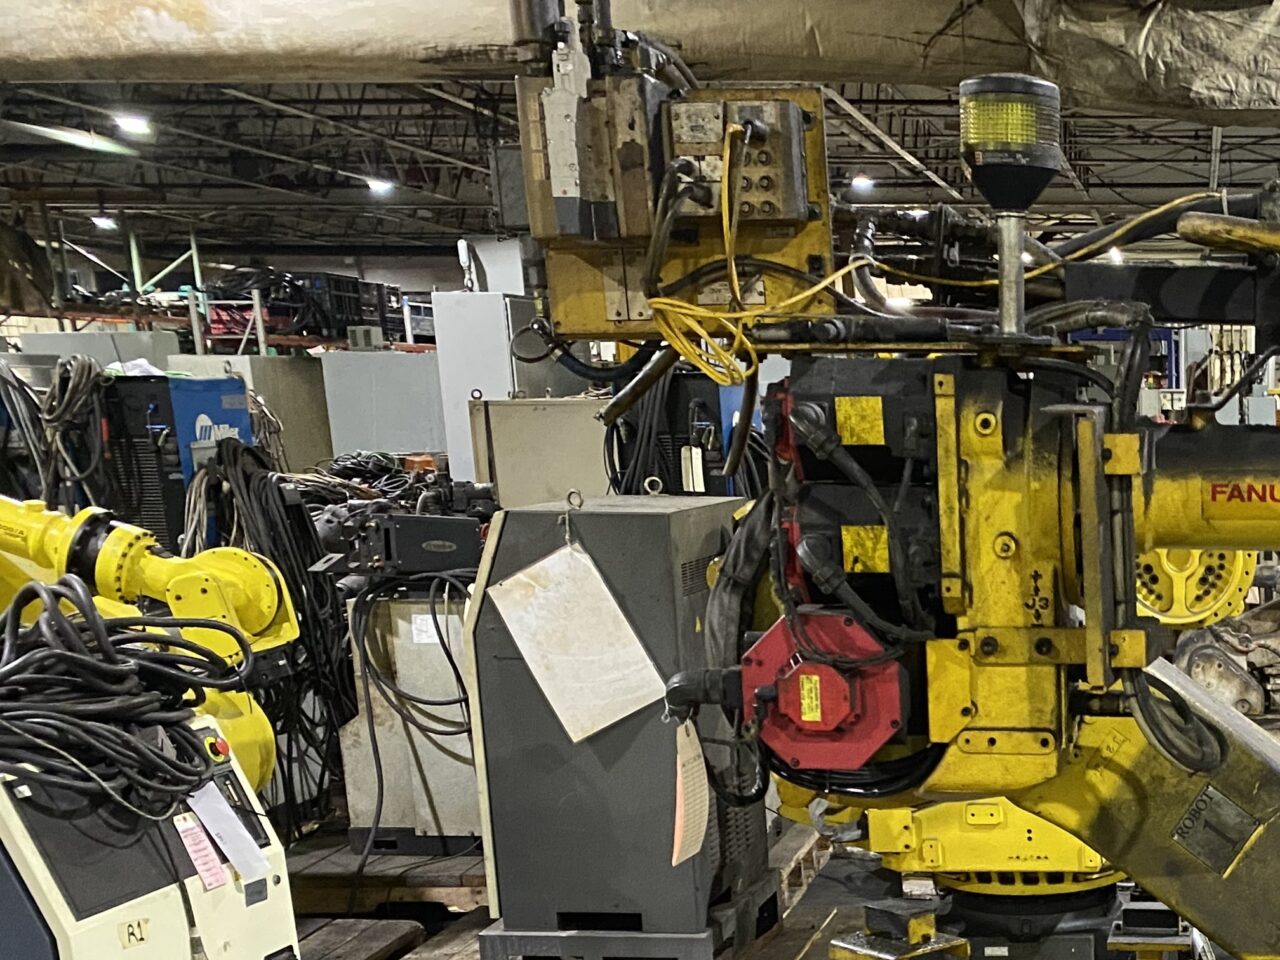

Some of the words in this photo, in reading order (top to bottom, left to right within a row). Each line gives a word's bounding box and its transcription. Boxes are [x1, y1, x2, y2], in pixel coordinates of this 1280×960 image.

[1024, 597, 1049, 610] J3
[1176, 791, 1214, 840] ROBOT
[1203, 819, 1244, 852] 1
[127, 920, 145, 943] R1
